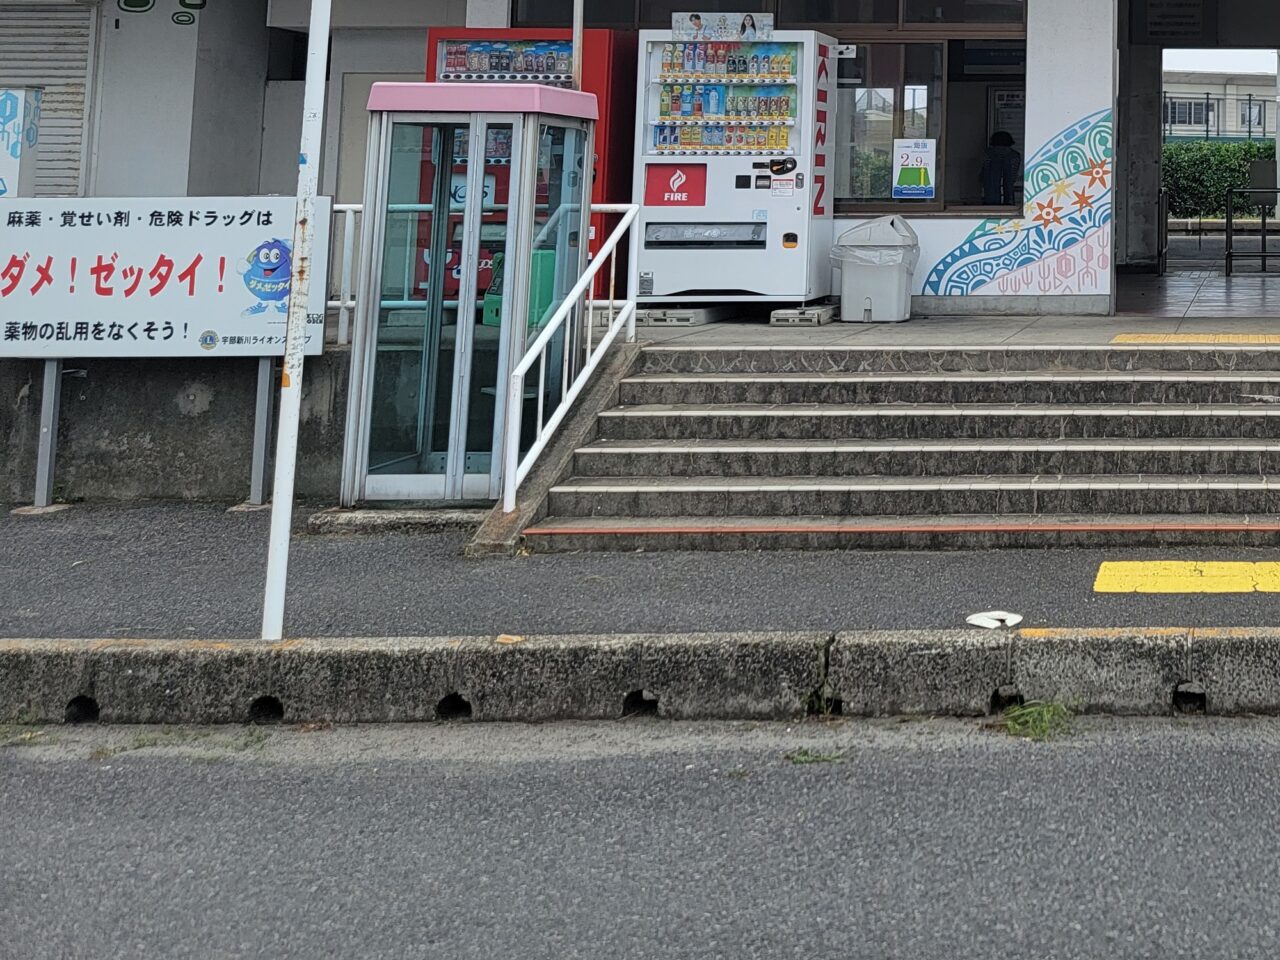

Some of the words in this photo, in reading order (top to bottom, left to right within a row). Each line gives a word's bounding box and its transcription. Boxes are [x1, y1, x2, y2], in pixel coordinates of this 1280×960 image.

[813, 44, 829, 216] KIRIN
[664, 193, 688, 201] FIRE
[7, 210, 273, 228] 麻薬・覚せい剤・危険ドラッグは
[0, 252, 226, 298] ダメ！ゼッタイ！
[4, 321, 189, 341] 薬物の乱用をなくそう！
[221, 335, 312, 345] 宇部新川ライオンブ
